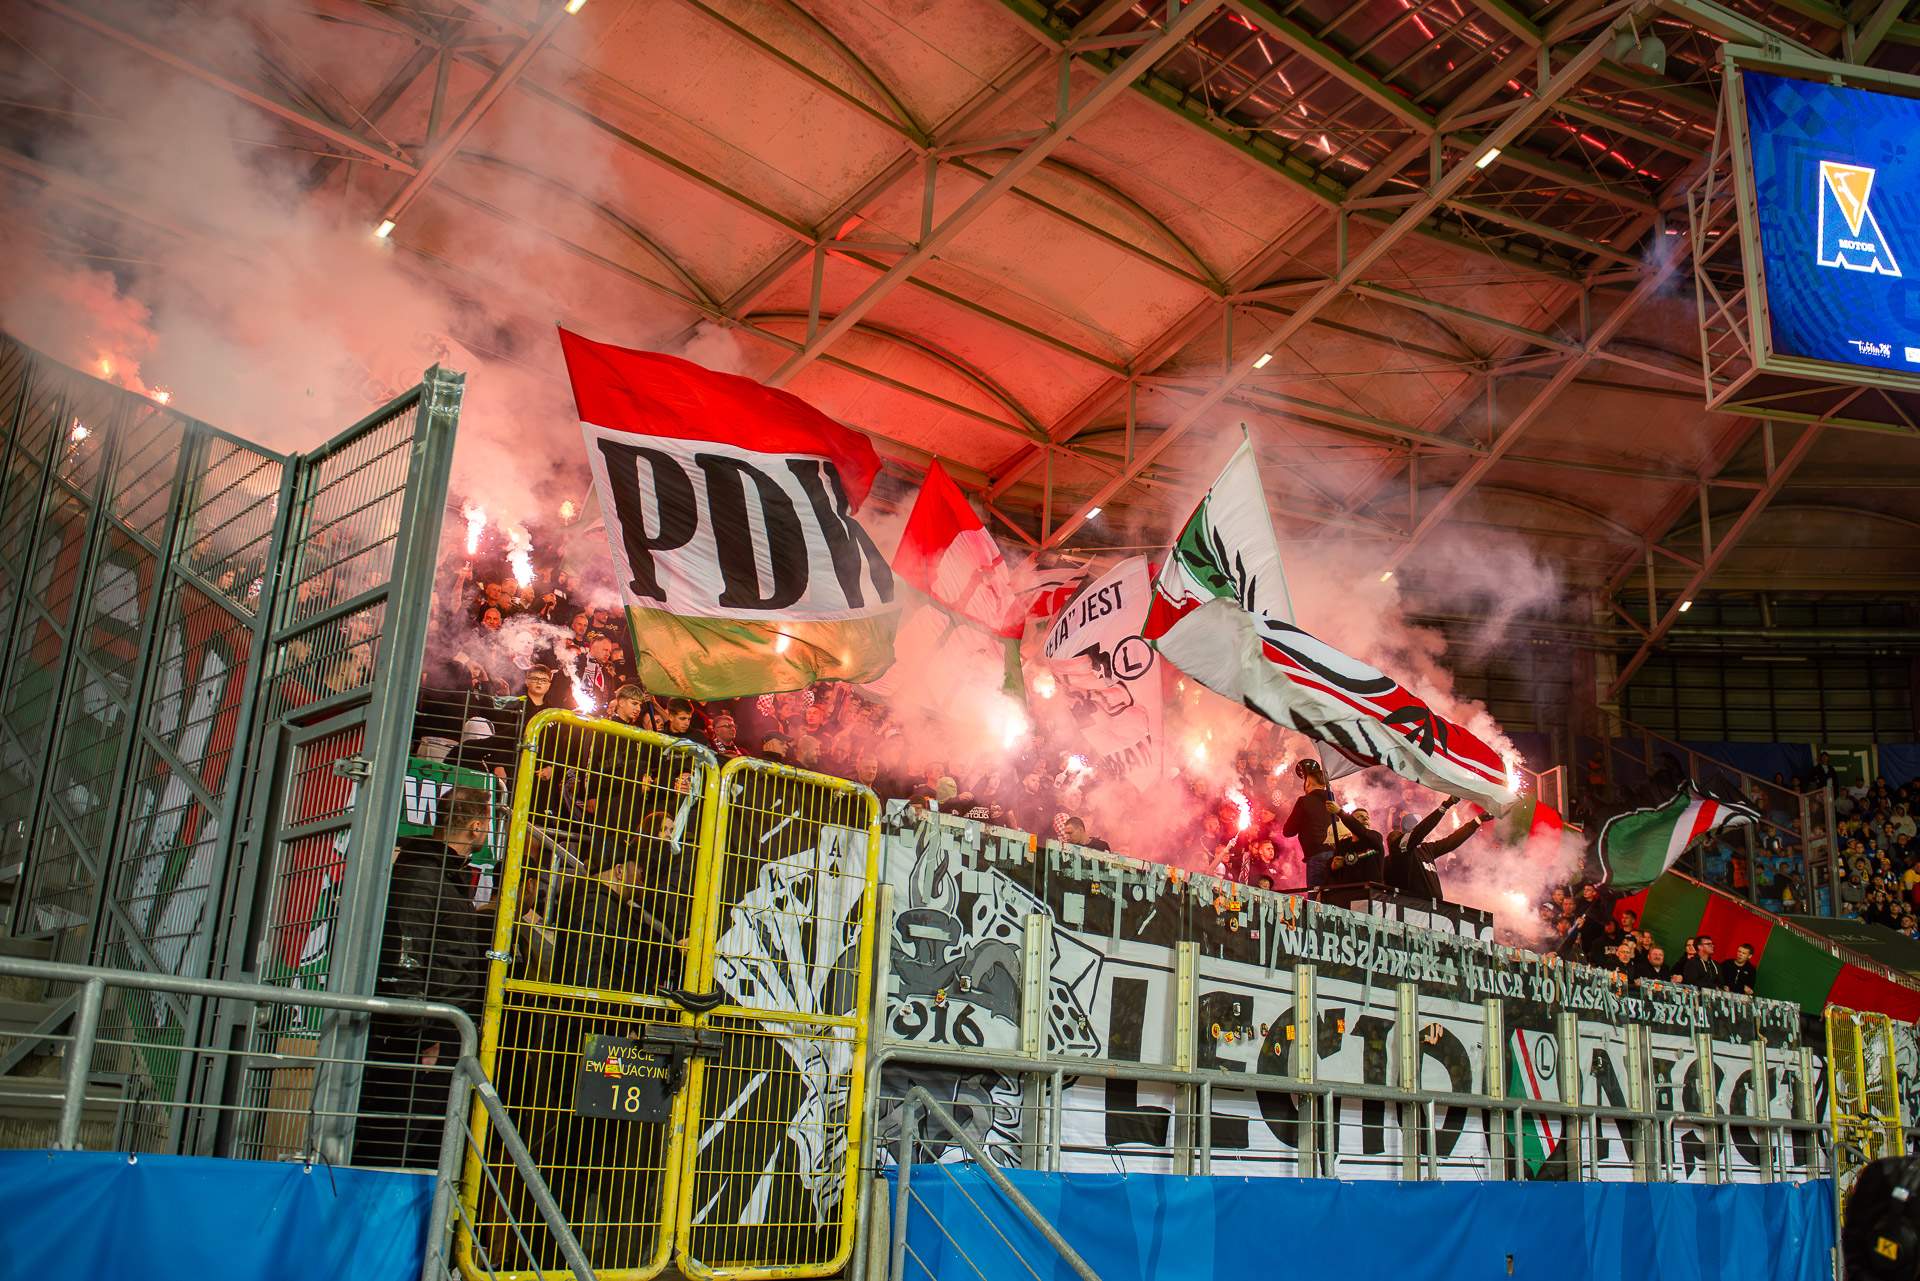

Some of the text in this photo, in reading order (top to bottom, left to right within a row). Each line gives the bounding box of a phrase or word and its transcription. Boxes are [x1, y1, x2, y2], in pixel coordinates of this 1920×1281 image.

[1838, 239, 1876, 253] MOTOR
[1079, 580, 1123, 628] JEST
[1279, 925, 1458, 986] WARSZAWSKA
[885, 1000, 985, 1048] 916
[607, 1045, 655, 1062] WYJŚCIE
[585, 1060, 669, 1080] EWUACYJNE
[611, 1084, 641, 1113] 18
